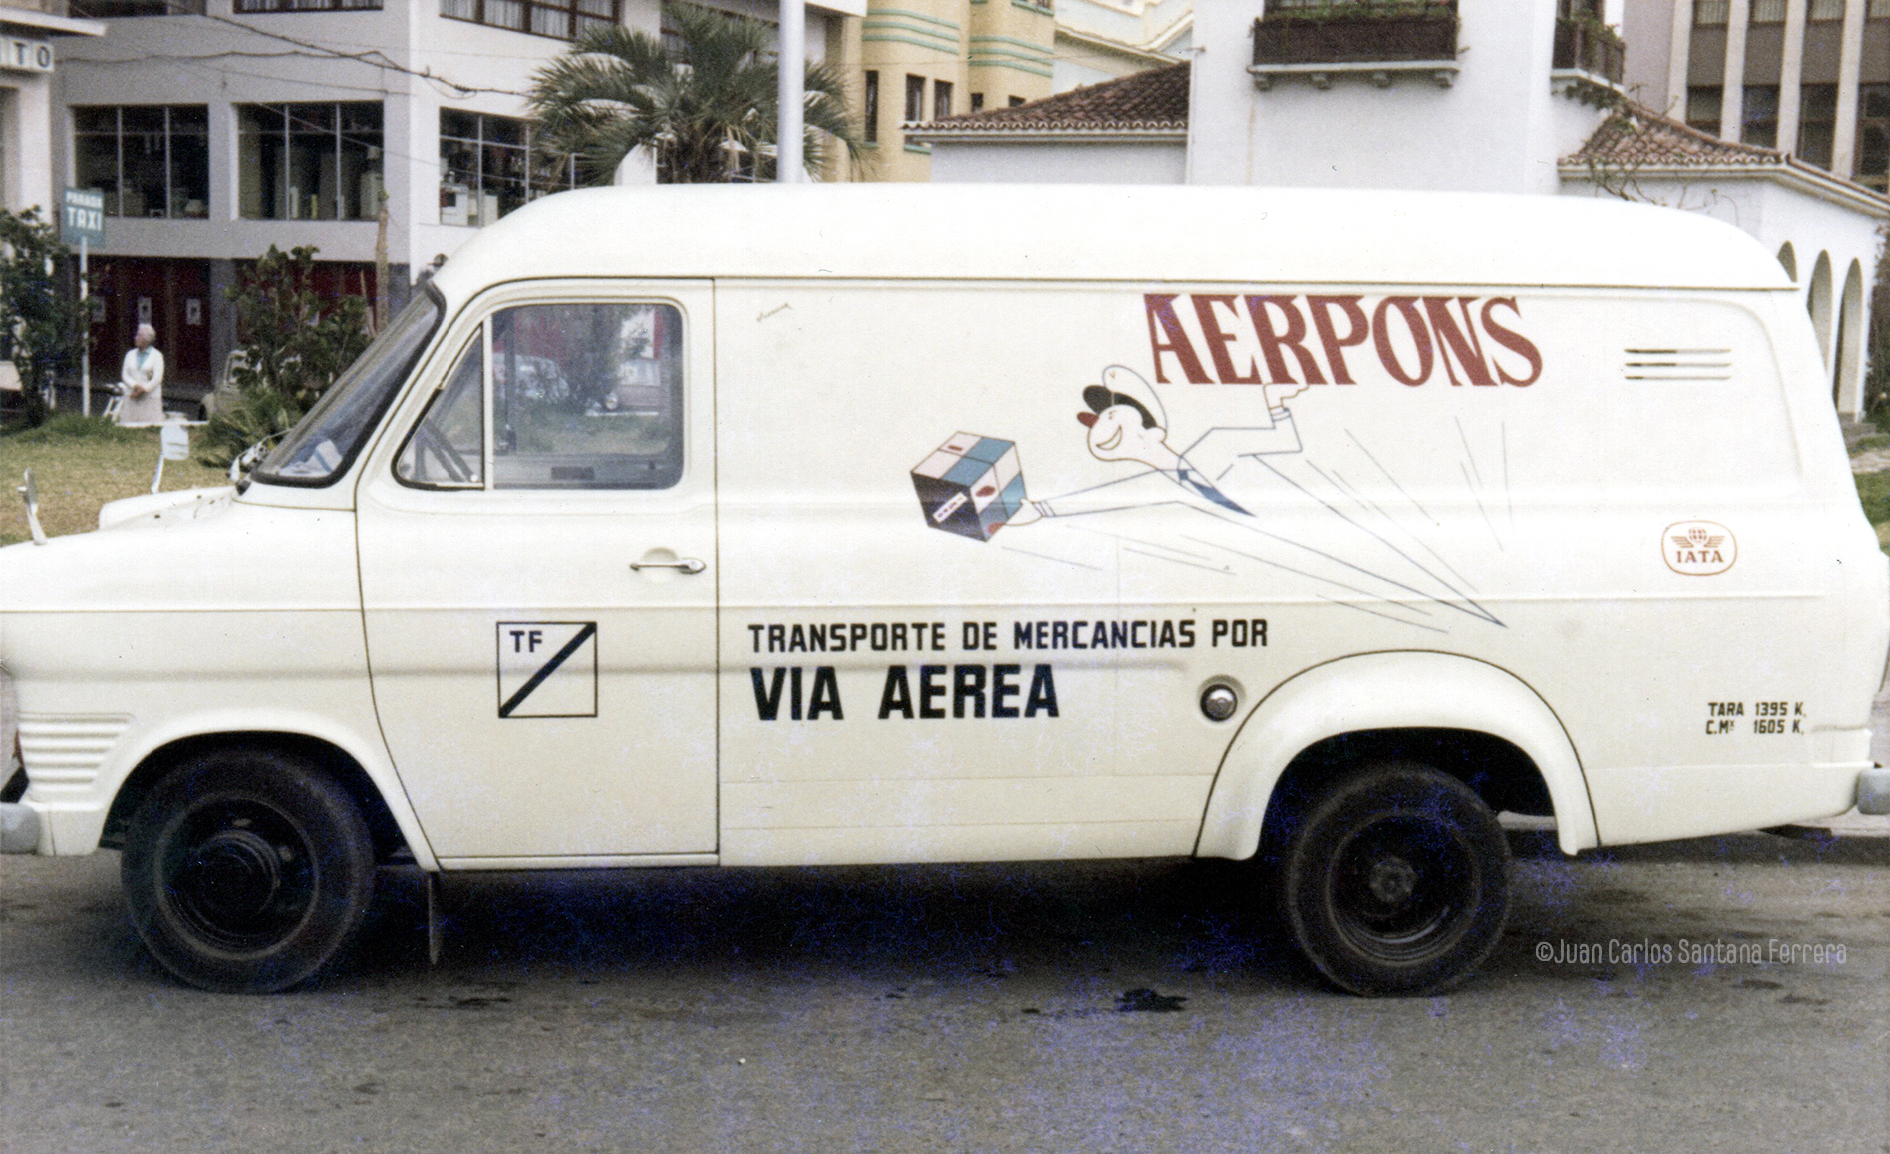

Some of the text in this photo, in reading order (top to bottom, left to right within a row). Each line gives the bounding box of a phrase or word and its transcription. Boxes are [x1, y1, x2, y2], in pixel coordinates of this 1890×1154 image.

[67, 206, 102, 230] TAXI
[1143, 293, 1542, 387] AERPONS
[1676, 549, 1724, 563] IATA
[509, 630, 543, 653] TF
[747, 618, 1268, 653] TRANSPORTE DE MERCANCIAS POR
[750, 663, 1060, 721] VIA AEREA
[1707, 702, 1744, 717] TARA
[1755, 701, 1788, 717] 1395
[1753, 719, 1786, 735] 1605
